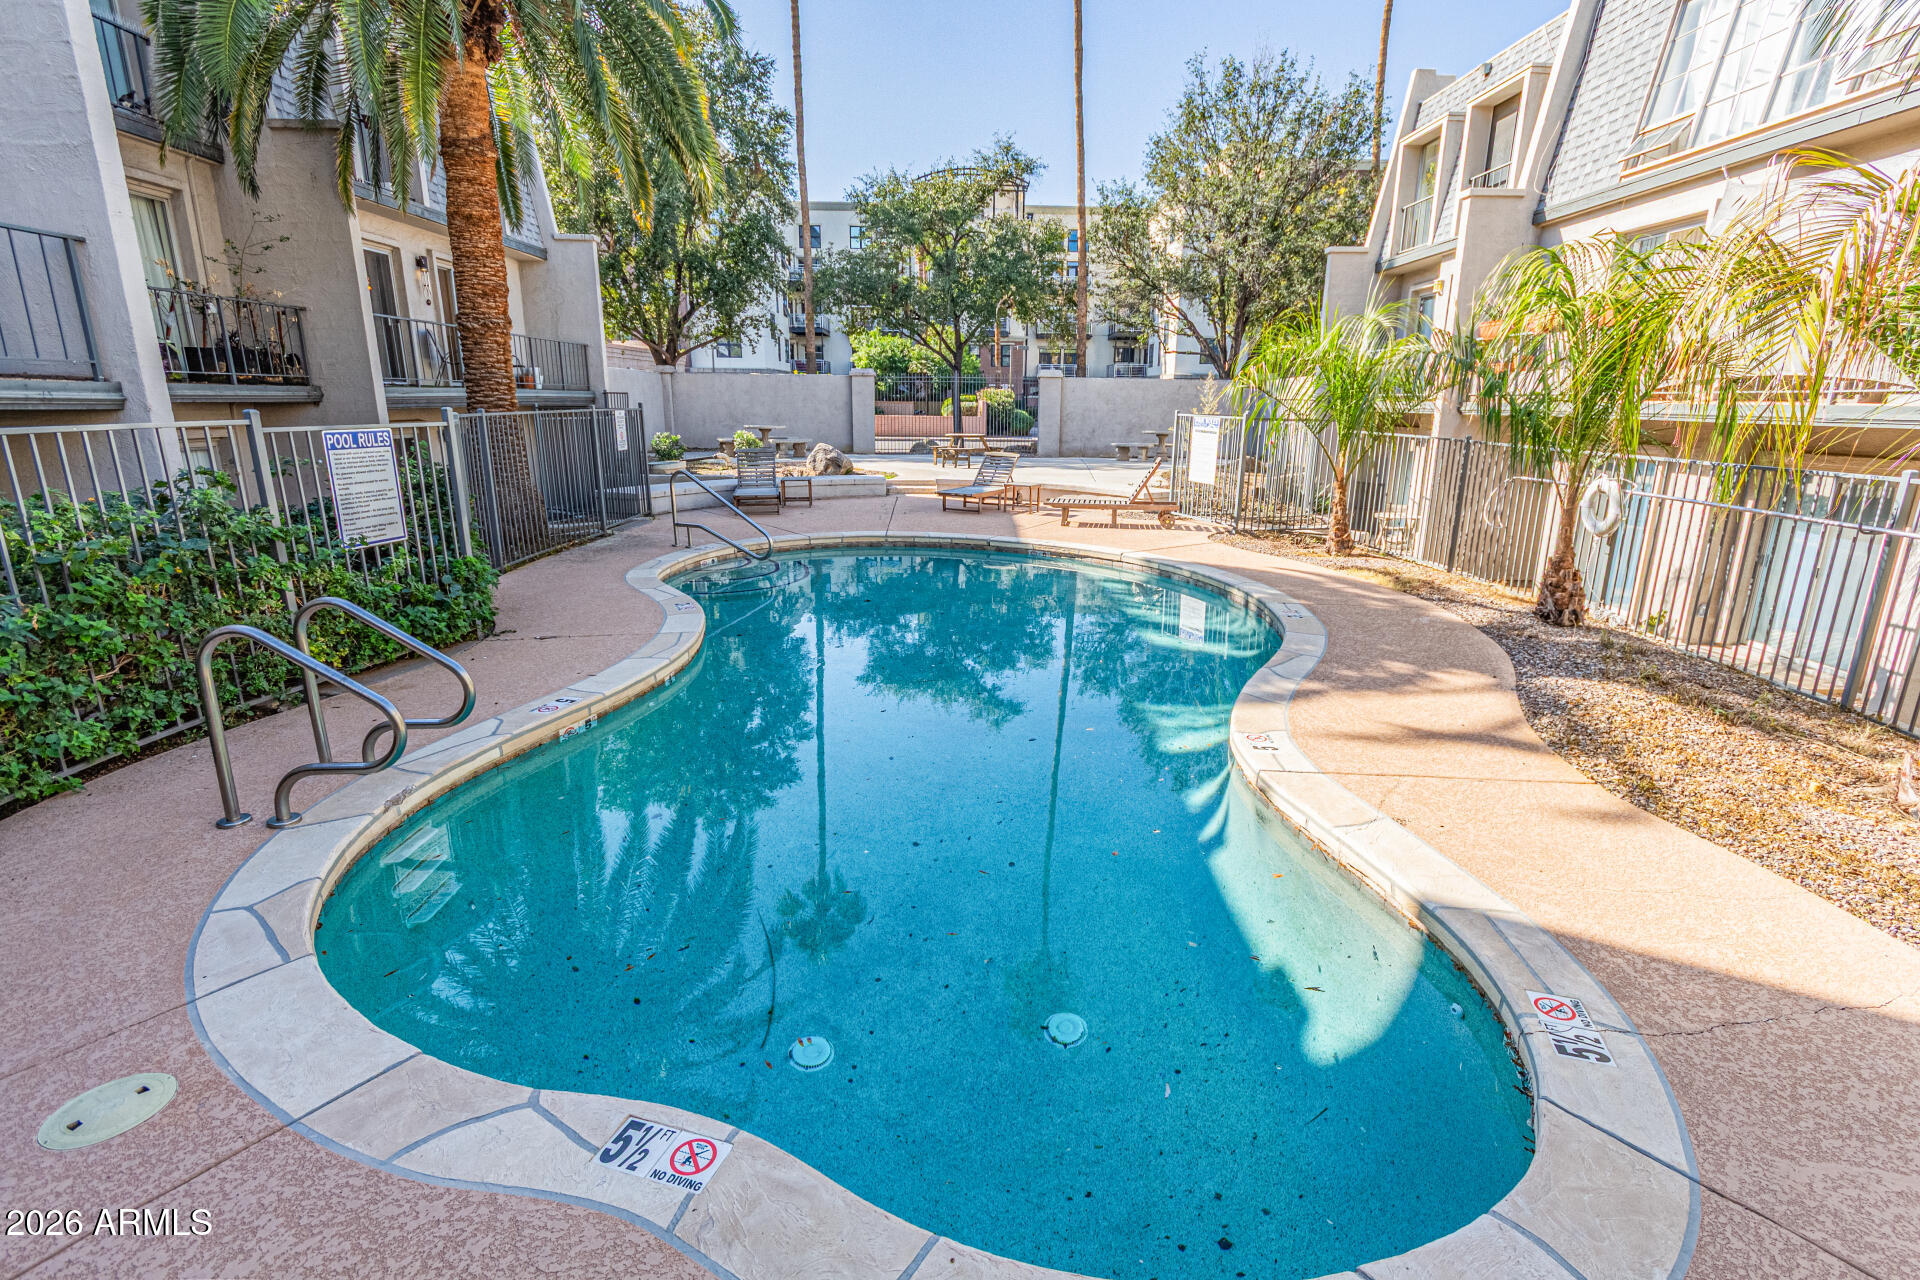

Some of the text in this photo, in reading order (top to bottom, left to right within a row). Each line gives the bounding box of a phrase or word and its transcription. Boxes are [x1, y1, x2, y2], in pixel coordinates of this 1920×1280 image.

[326, 432, 390, 449] POOL RULES
[660, 1129, 677, 1142] FT
[650, 1169, 703, 1192] NO DIVING
